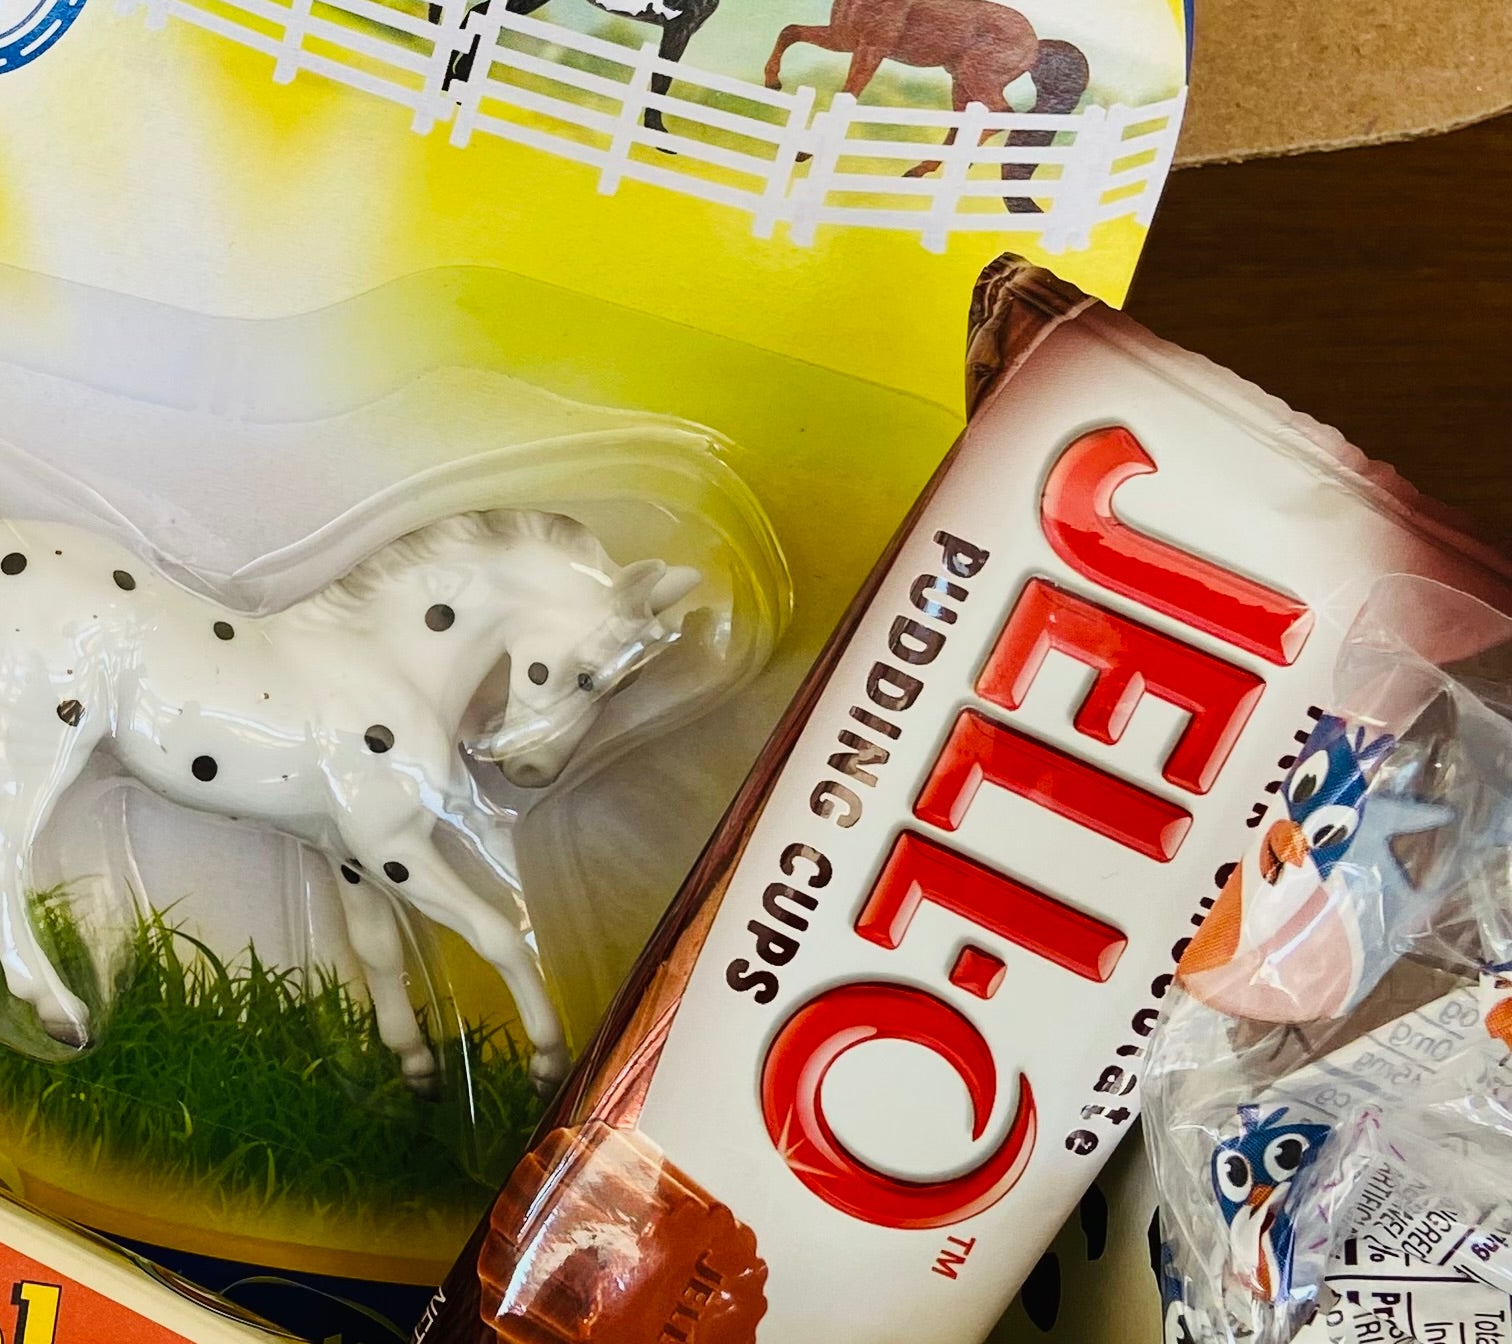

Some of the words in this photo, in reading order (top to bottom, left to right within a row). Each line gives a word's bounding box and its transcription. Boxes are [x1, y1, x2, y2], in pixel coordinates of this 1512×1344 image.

[758, 422, 1318, 1232] JELL-O
[809, 529, 990, 830] PUDDING
[725, 842, 833, 1006] CUPS
